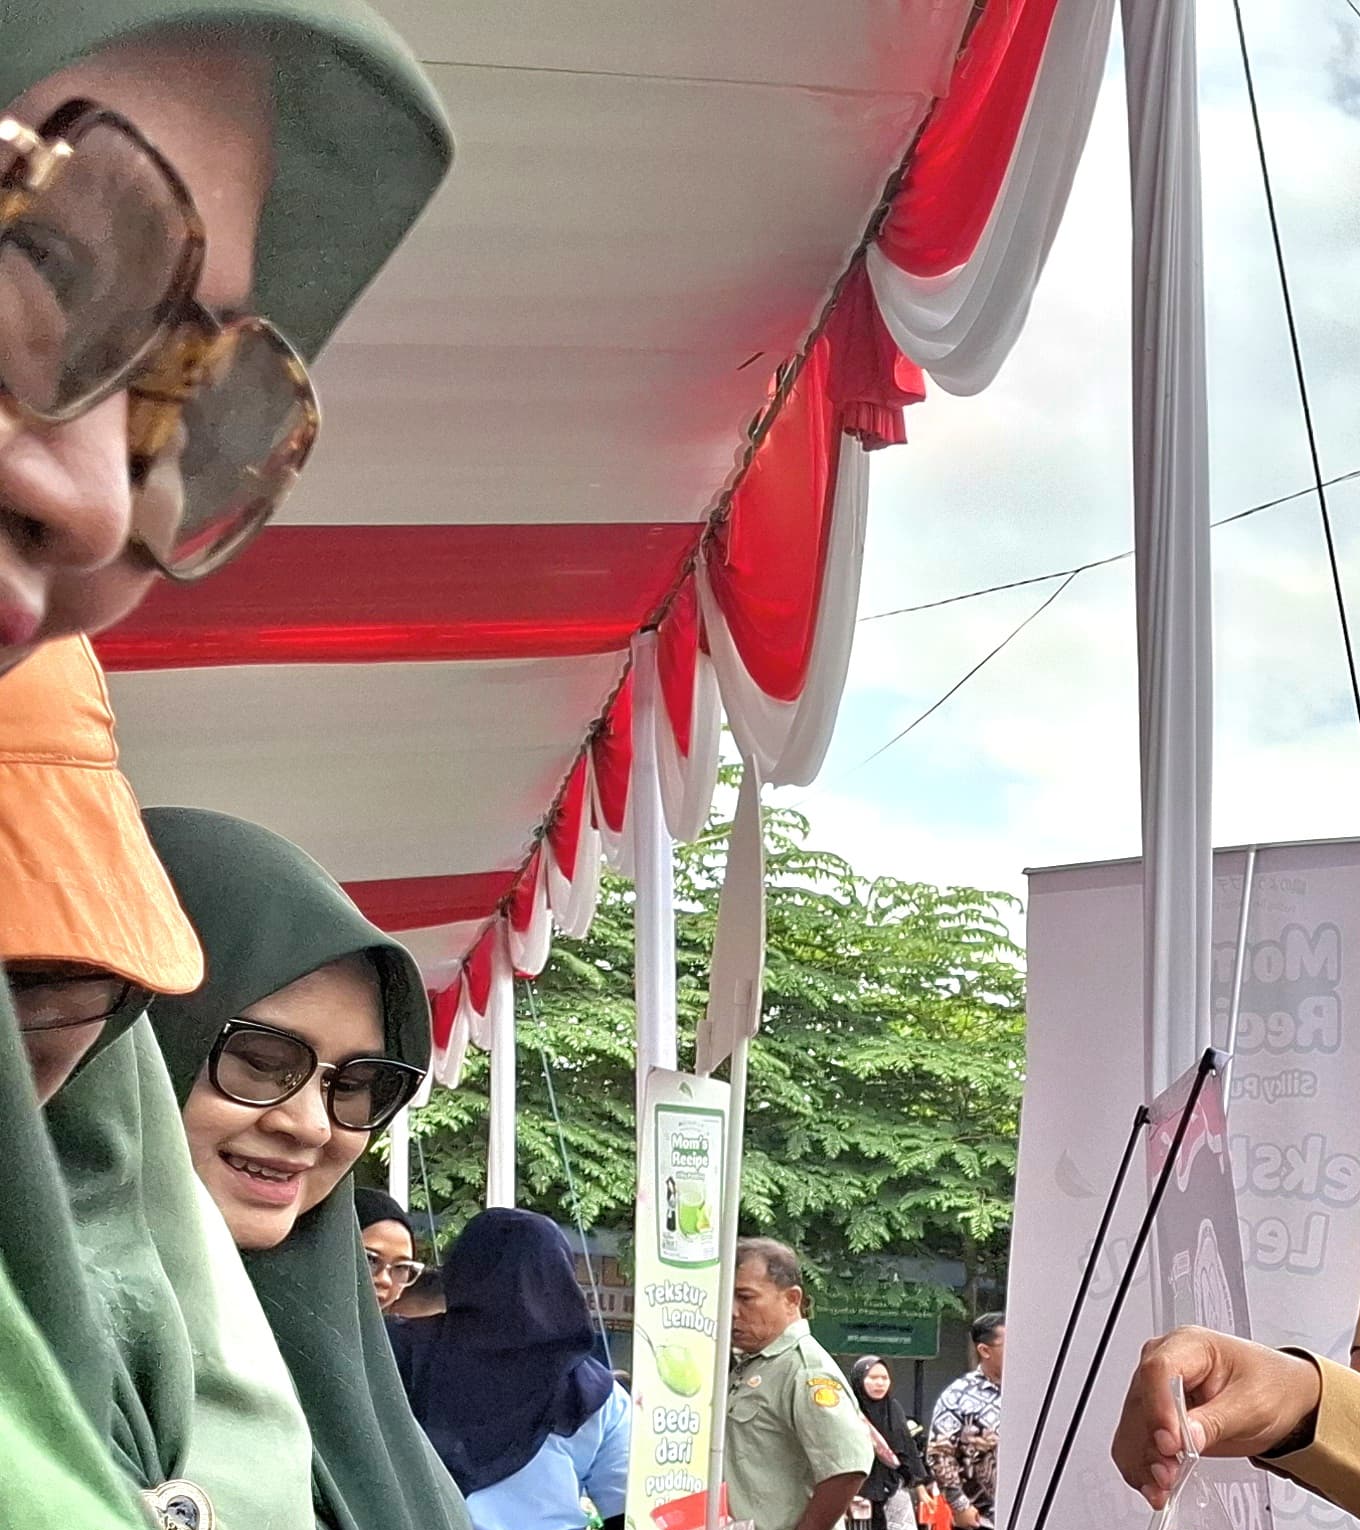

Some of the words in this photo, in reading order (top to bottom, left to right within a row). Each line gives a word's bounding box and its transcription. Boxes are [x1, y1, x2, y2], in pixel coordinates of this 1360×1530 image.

[671, 1132, 709, 1151] Mom's
[671, 1151, 709, 1170] Recipe
[644, 1280, 707, 1308] Tekstur
[652, 1404, 701, 1435] Beda
[655, 1437, 693, 1467] dari
